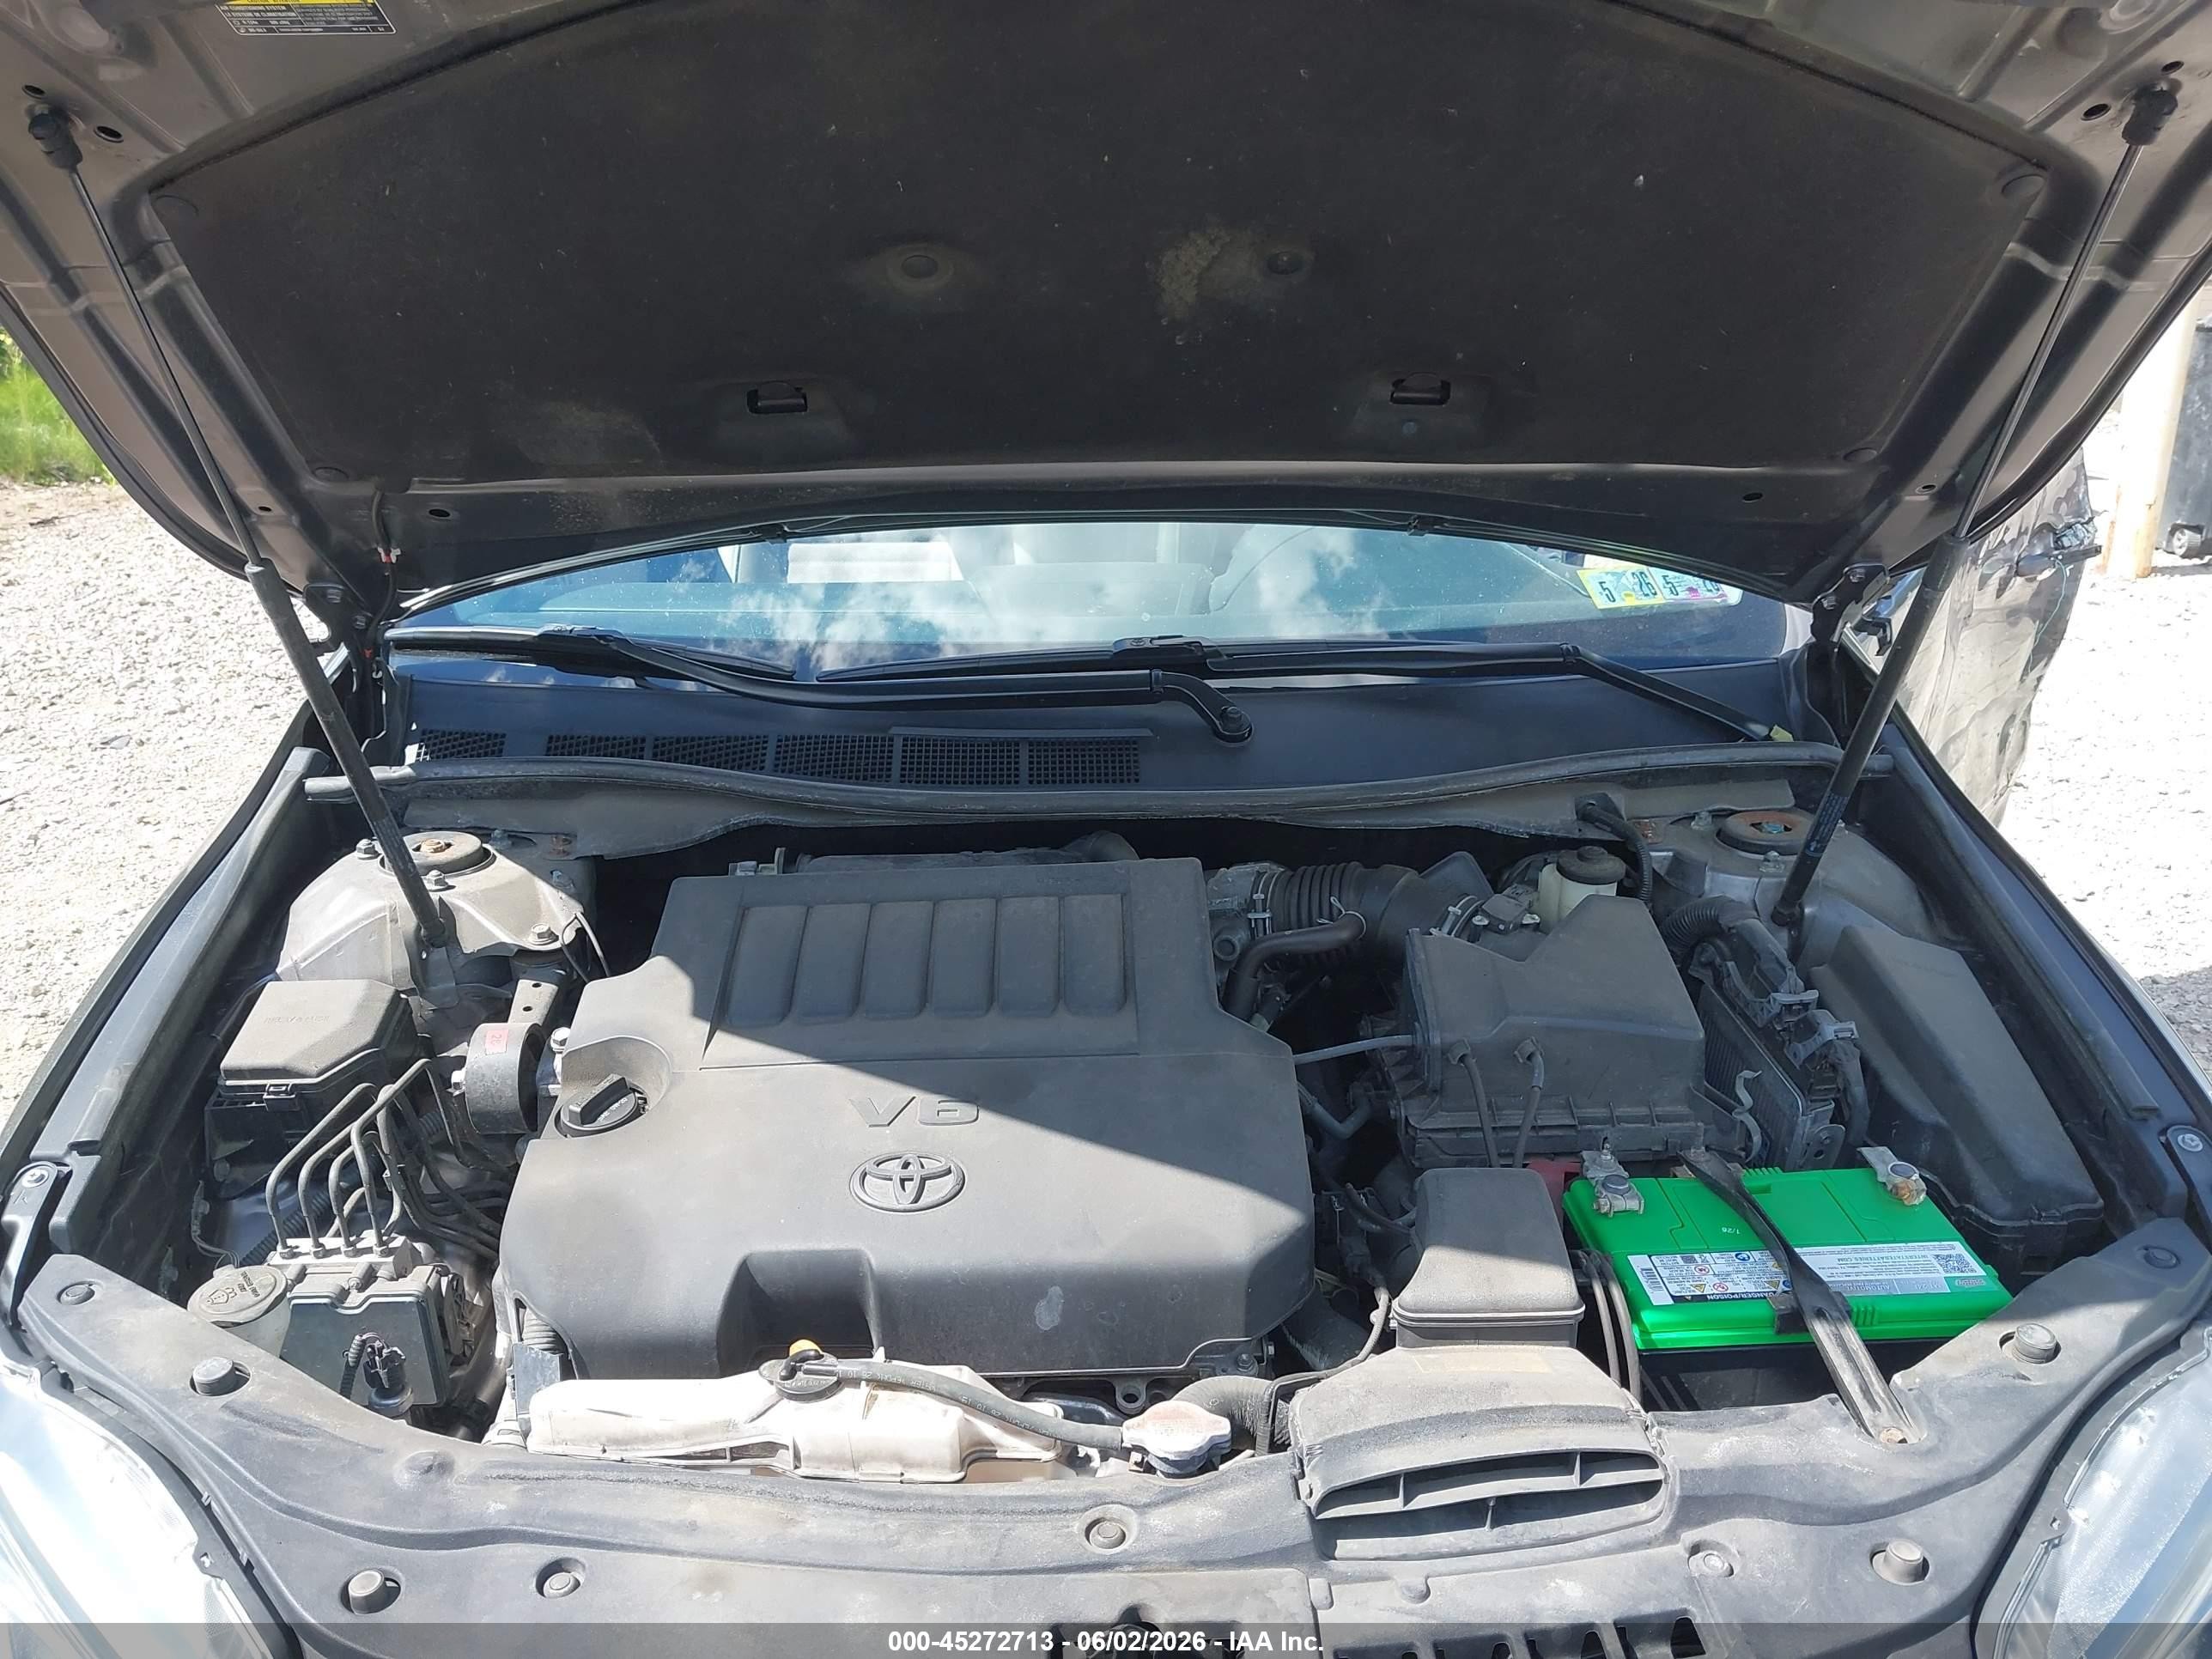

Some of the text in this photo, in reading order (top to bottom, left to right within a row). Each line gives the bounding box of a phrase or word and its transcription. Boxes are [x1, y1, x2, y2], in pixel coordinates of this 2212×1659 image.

[1599, 581, 1616, 603] 5
[1632, 571, 1658, 598] 26
[1662, 574, 1680, 596] 5
[848, 1096, 980, 1127] V6
